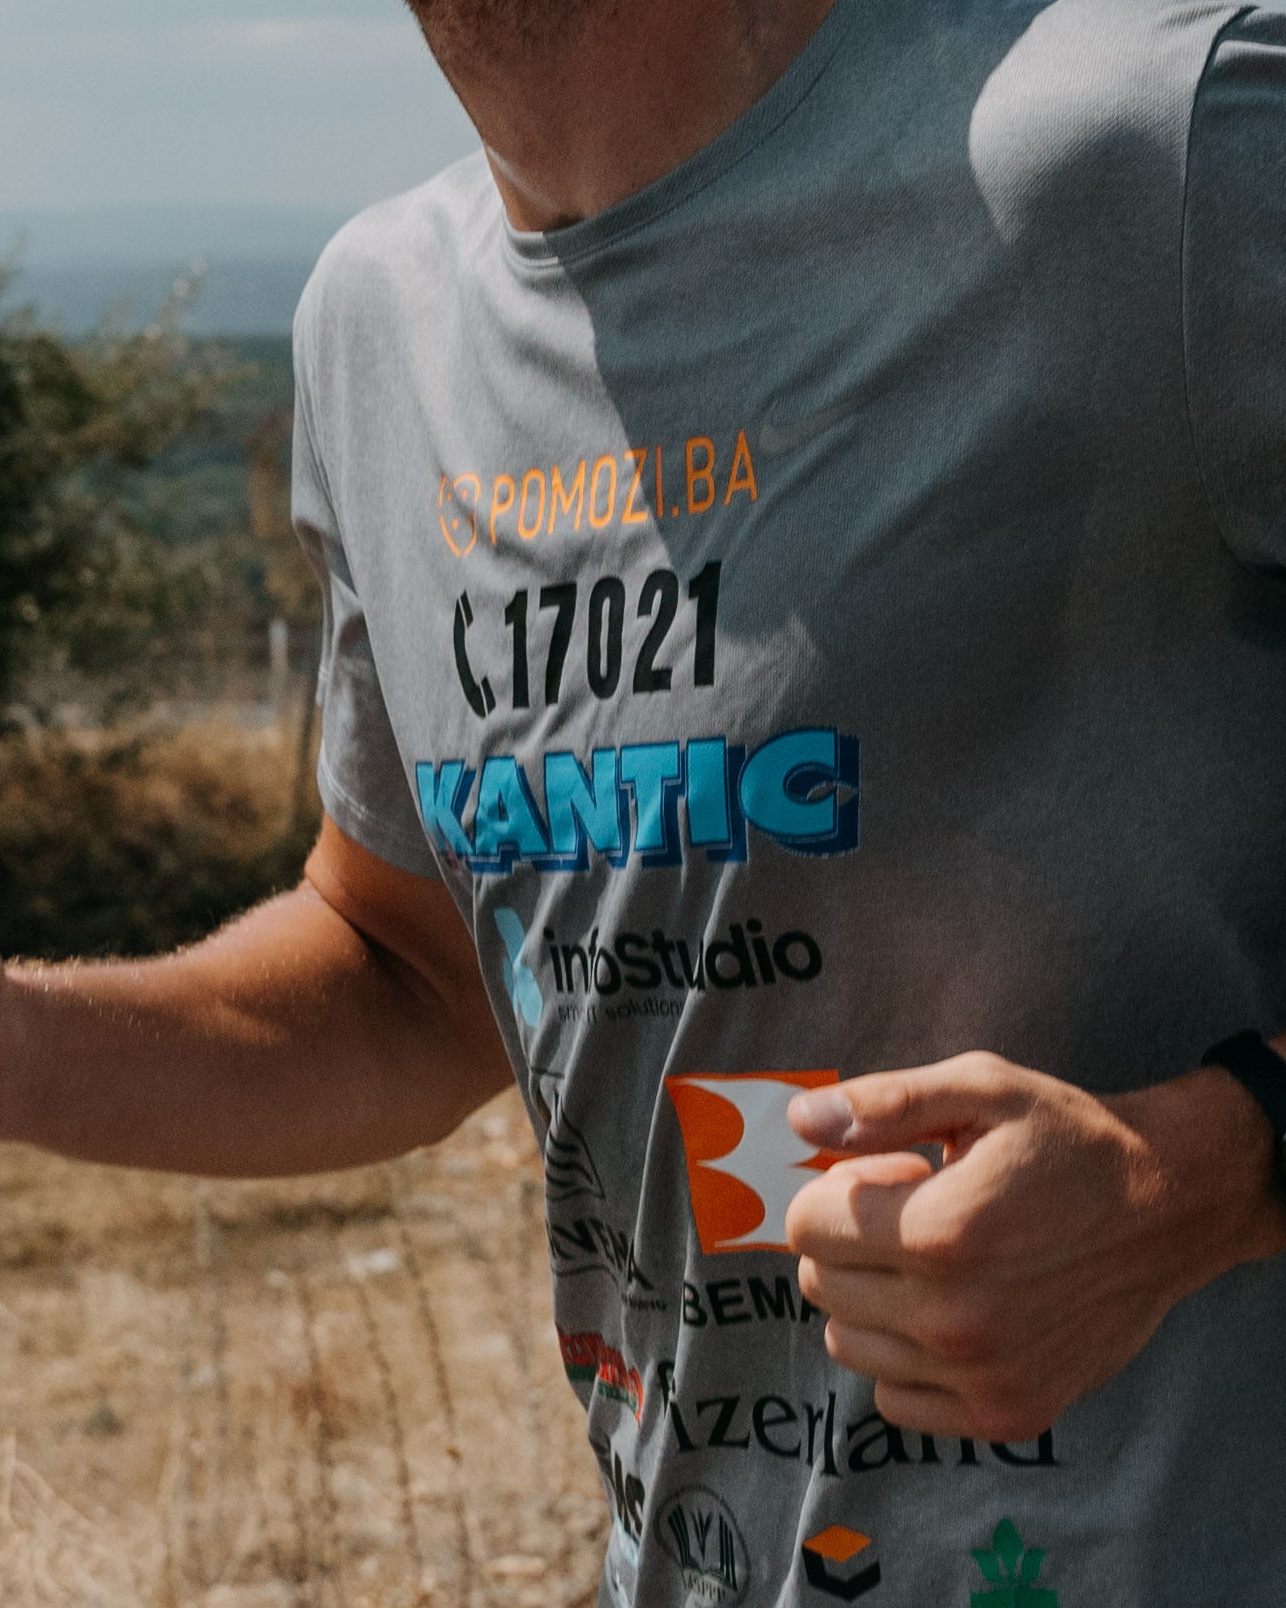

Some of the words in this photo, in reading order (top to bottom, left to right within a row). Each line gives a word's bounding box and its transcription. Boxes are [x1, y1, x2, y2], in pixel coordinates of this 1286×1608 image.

[488, 429, 759, 546] POMOZI.BA
[504, 560, 722, 710] 17021
[415, 725, 860, 875] KANTIC
[543, 917, 823, 995] infoStudio
